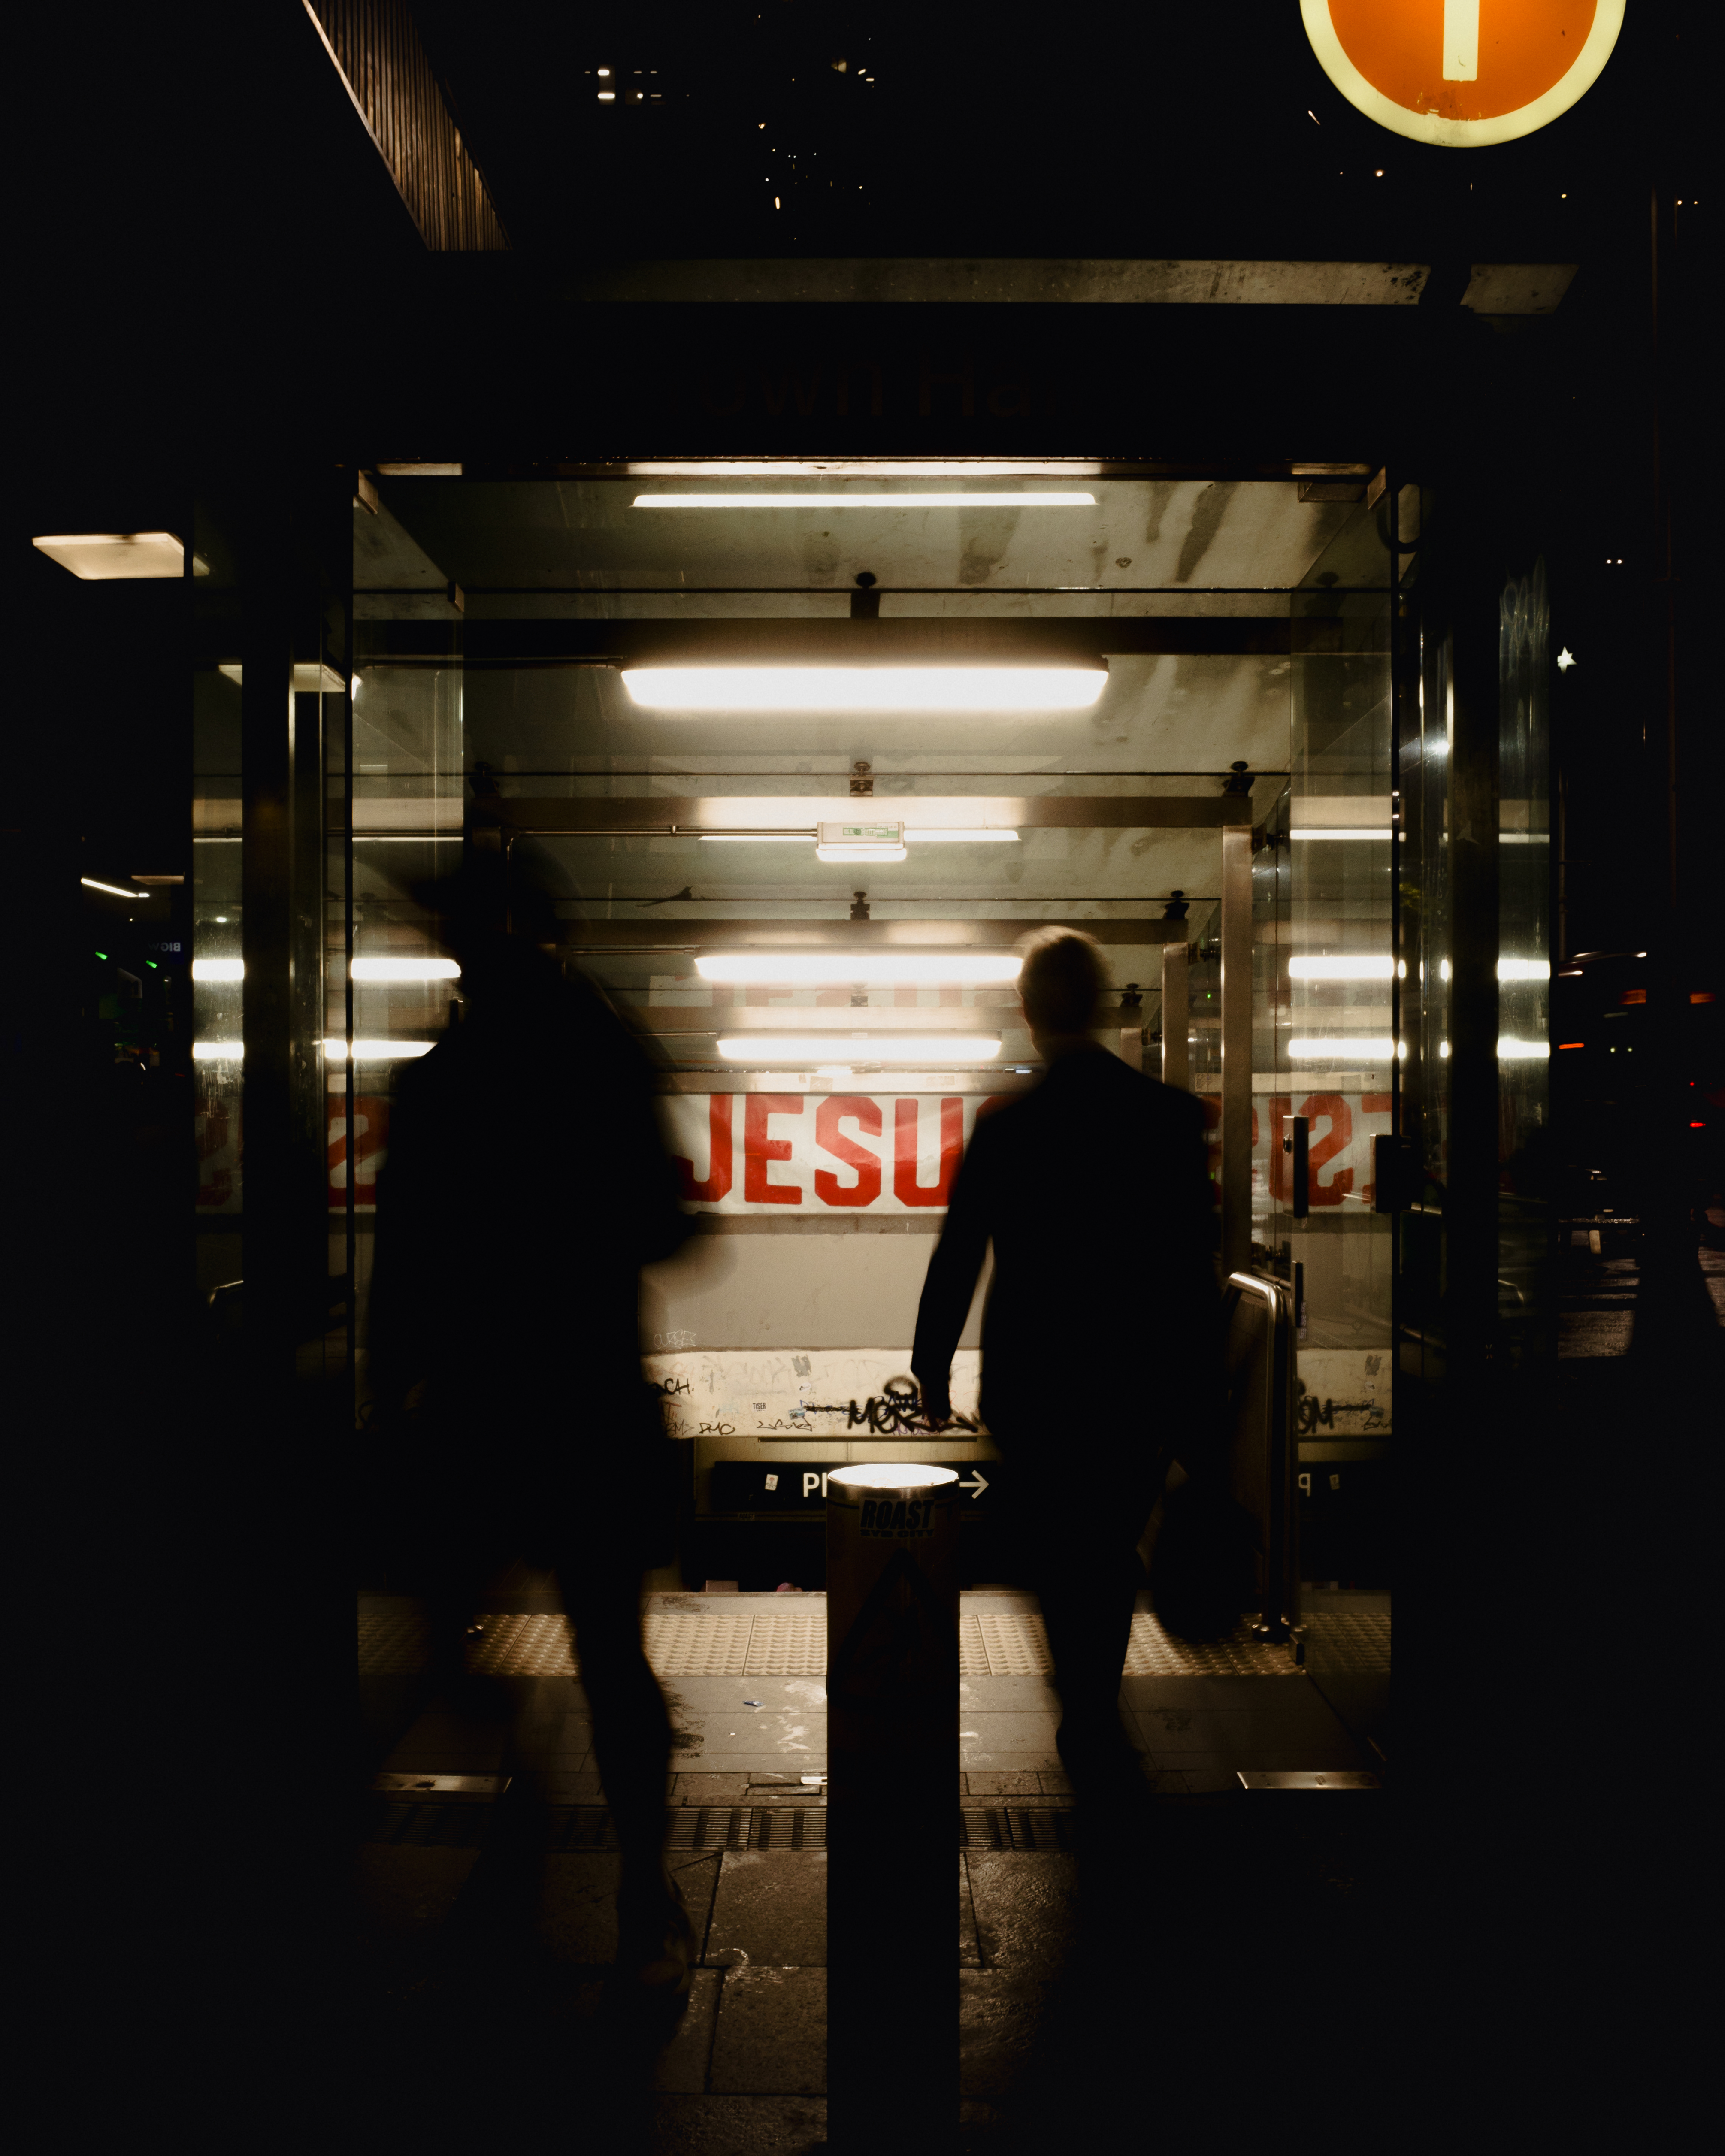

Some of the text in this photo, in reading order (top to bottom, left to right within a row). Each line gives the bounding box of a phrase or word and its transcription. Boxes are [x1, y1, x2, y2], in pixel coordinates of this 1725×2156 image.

[672, 1093, 1023, 1207] JESU
[860, 1500, 935, 1530] ROAST
[897, 1529, 935, 1538] CITY
